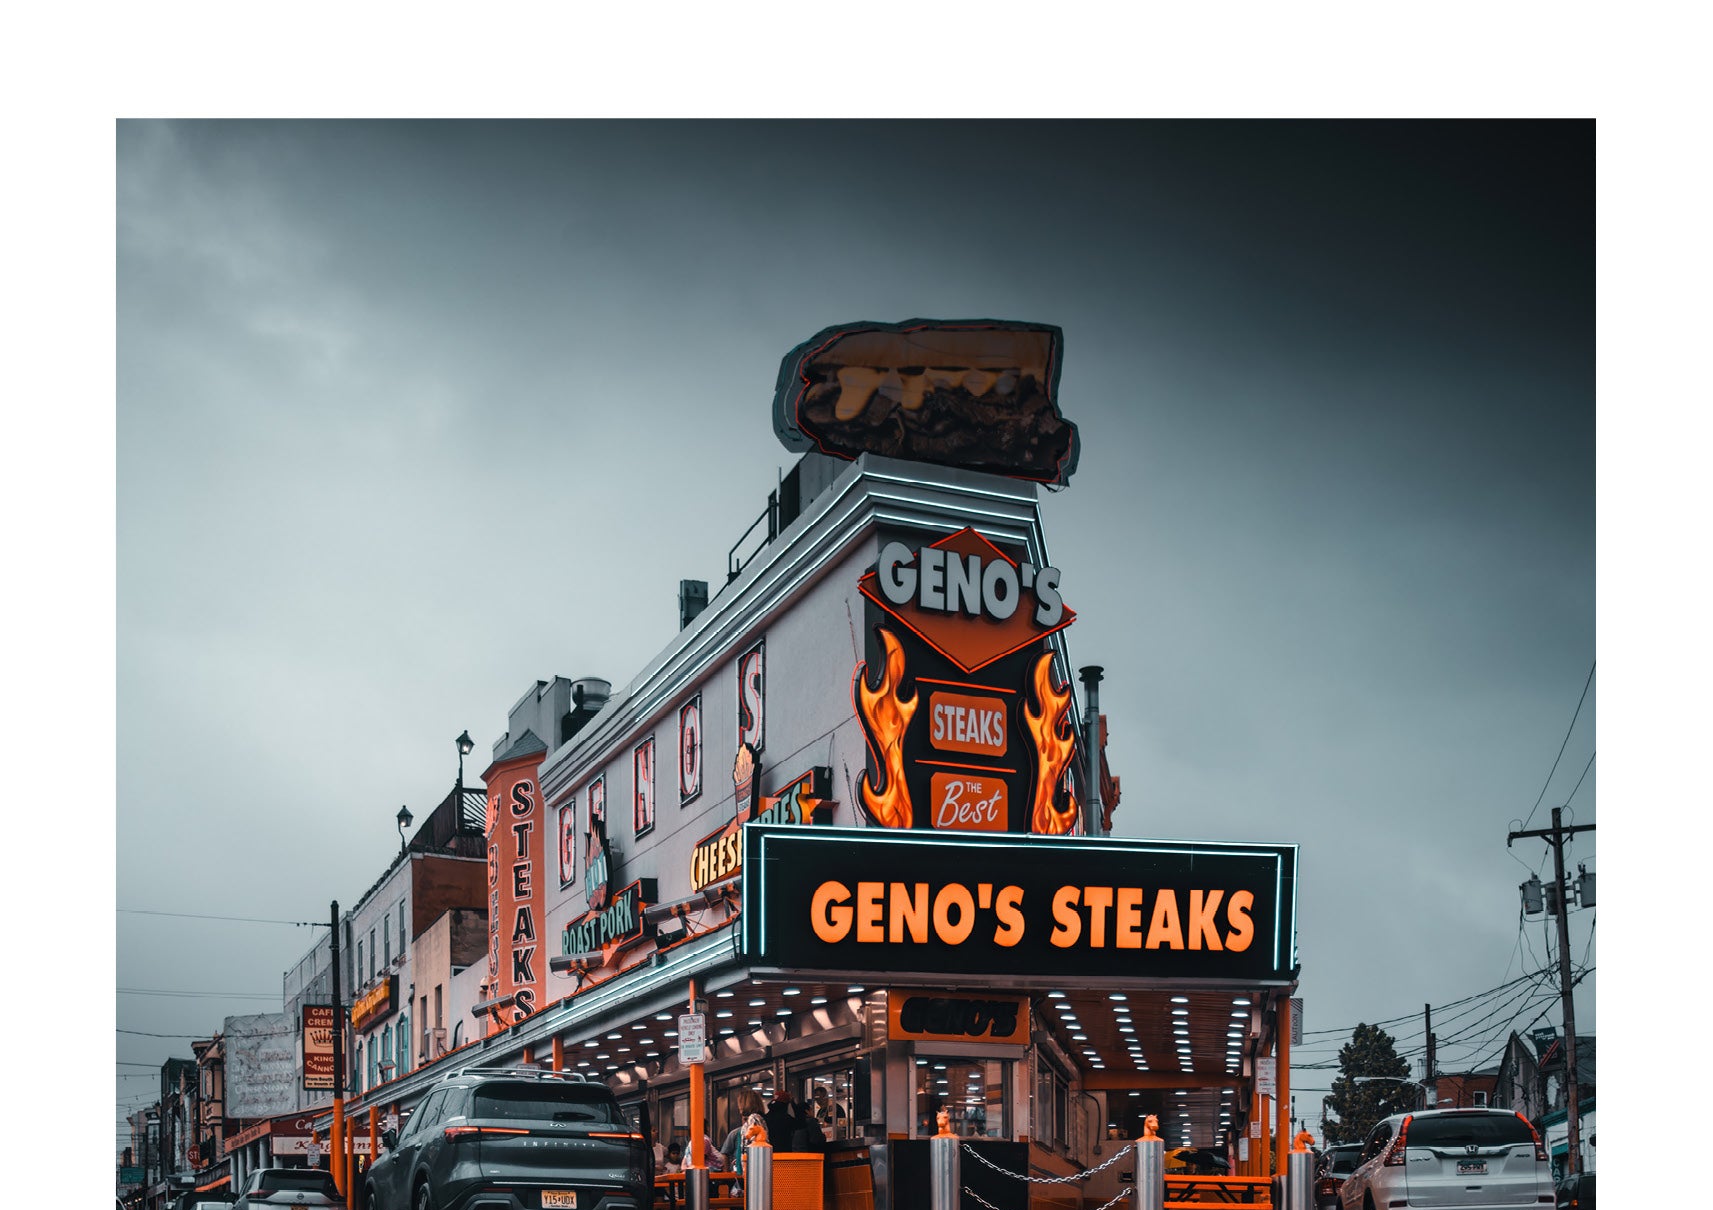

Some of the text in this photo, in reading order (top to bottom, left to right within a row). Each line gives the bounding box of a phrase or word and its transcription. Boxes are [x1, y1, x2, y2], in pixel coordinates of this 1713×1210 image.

[877, 541, 1063, 627] GENO'S
[933, 703, 1004, 747] STEAKS
[936, 780, 1003, 828] Best
[965, 781, 982, 794] THE
[510, 778, 537, 1022] STEAKS
[562, 889, 634, 956] ROAST PORK
[810, 879, 1255, 952] GENO'S STEAKS
[307, 1018, 334, 1026] CREM
[306, 1060, 334, 1073] CANNO
